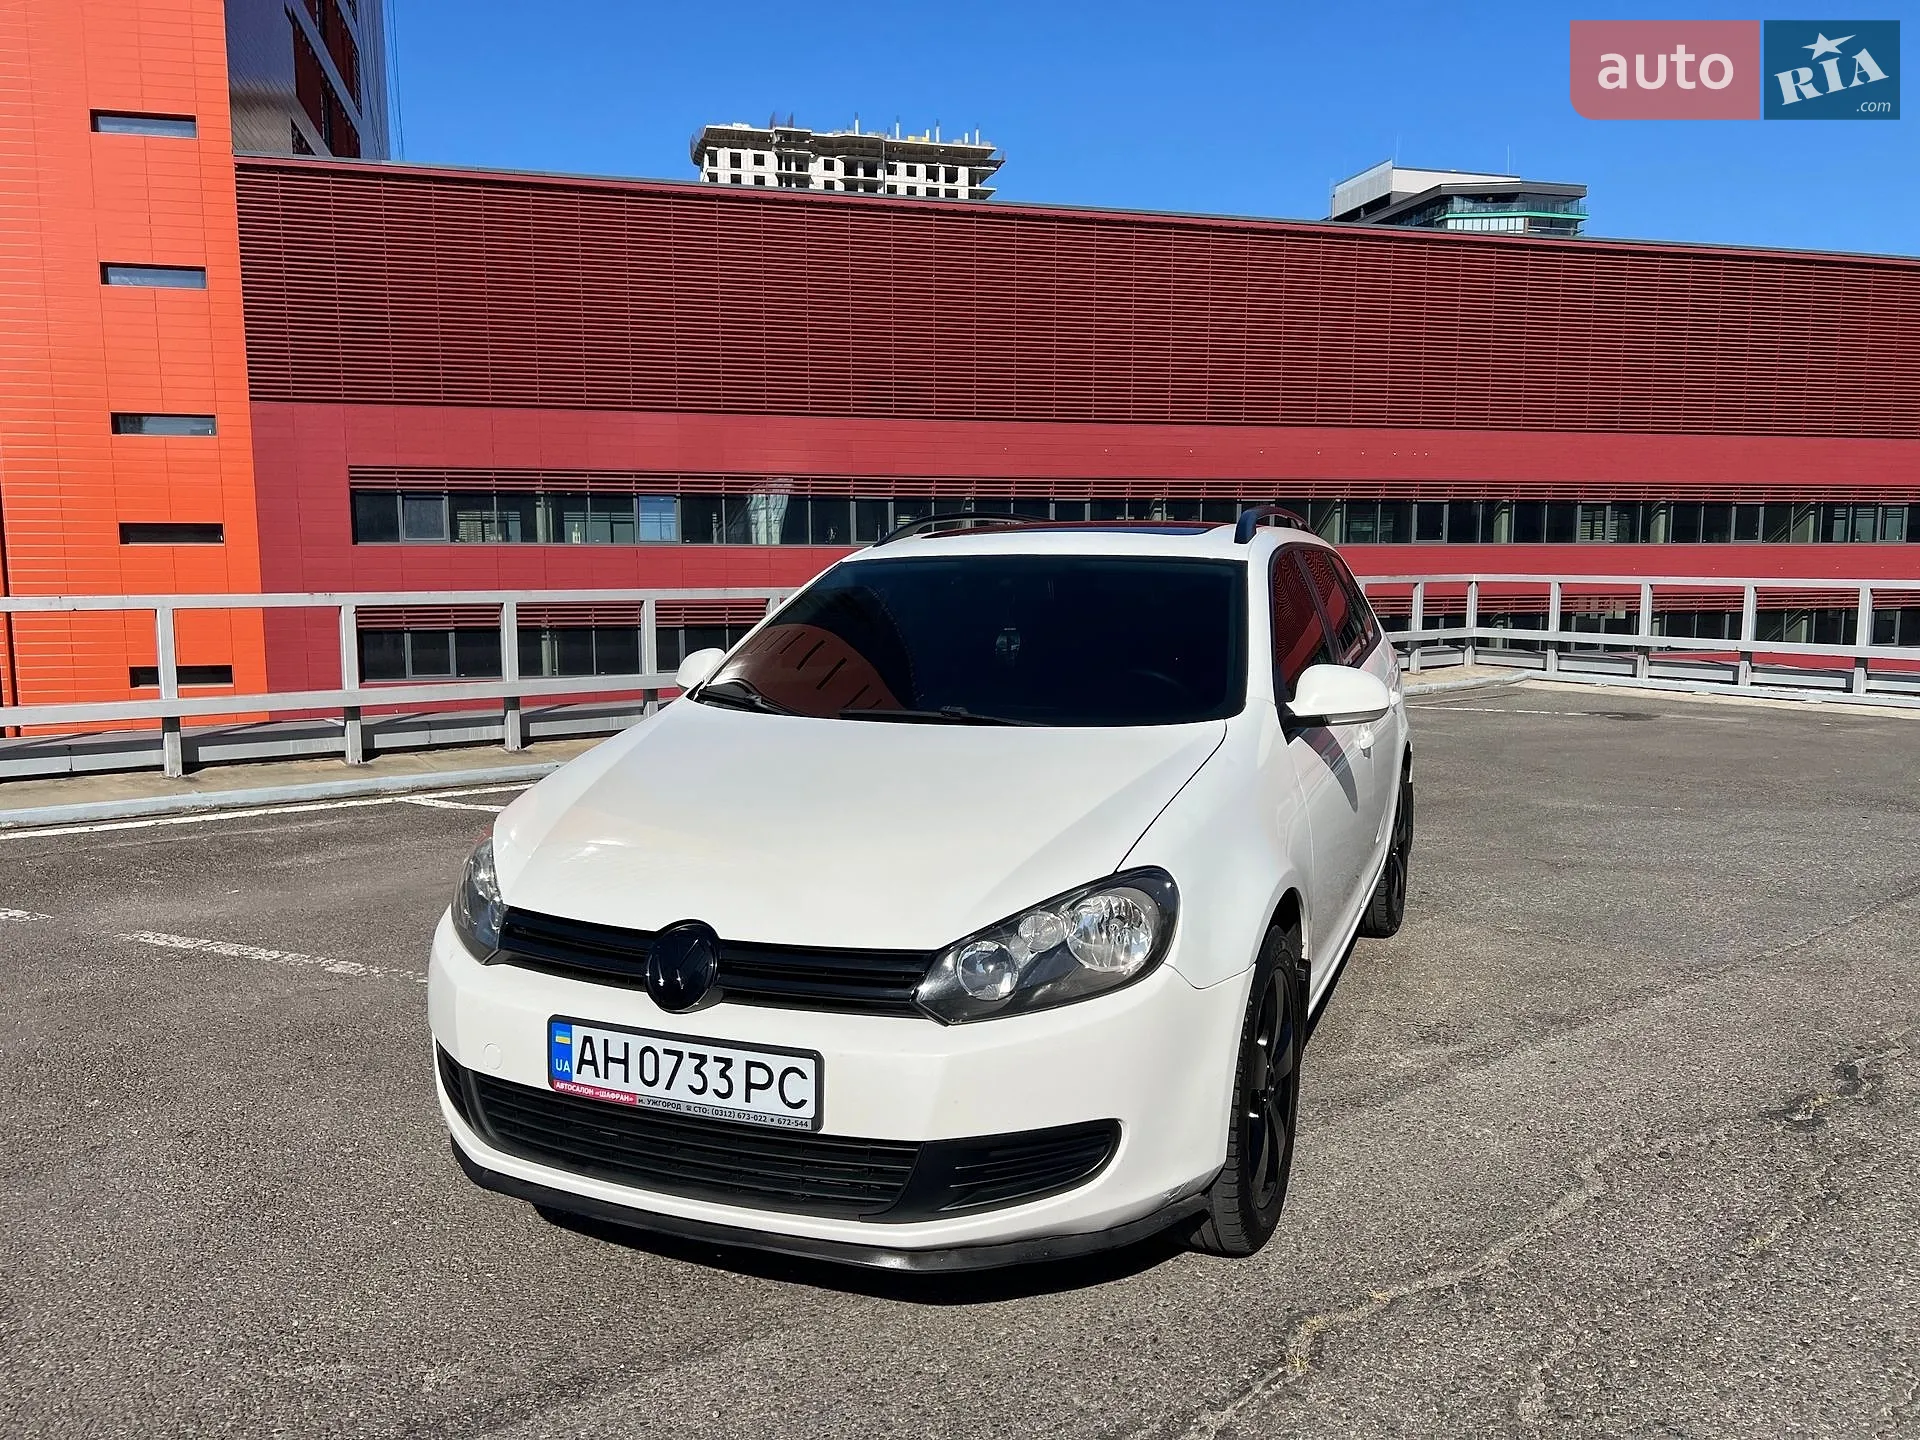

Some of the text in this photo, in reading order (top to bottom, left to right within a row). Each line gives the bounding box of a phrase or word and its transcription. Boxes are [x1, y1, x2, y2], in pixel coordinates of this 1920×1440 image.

[555, 1057, 571, 1073] UA
[556, 1081, 594, 1095] АВТОСАЛОН
[647, 1098, 682, 1111] УЖГОРОД
[711, 1108, 736, 1119] (0312)
[737, 1112, 768, 1123] 673-022
[777, 1118, 809, 1128] 672-544
